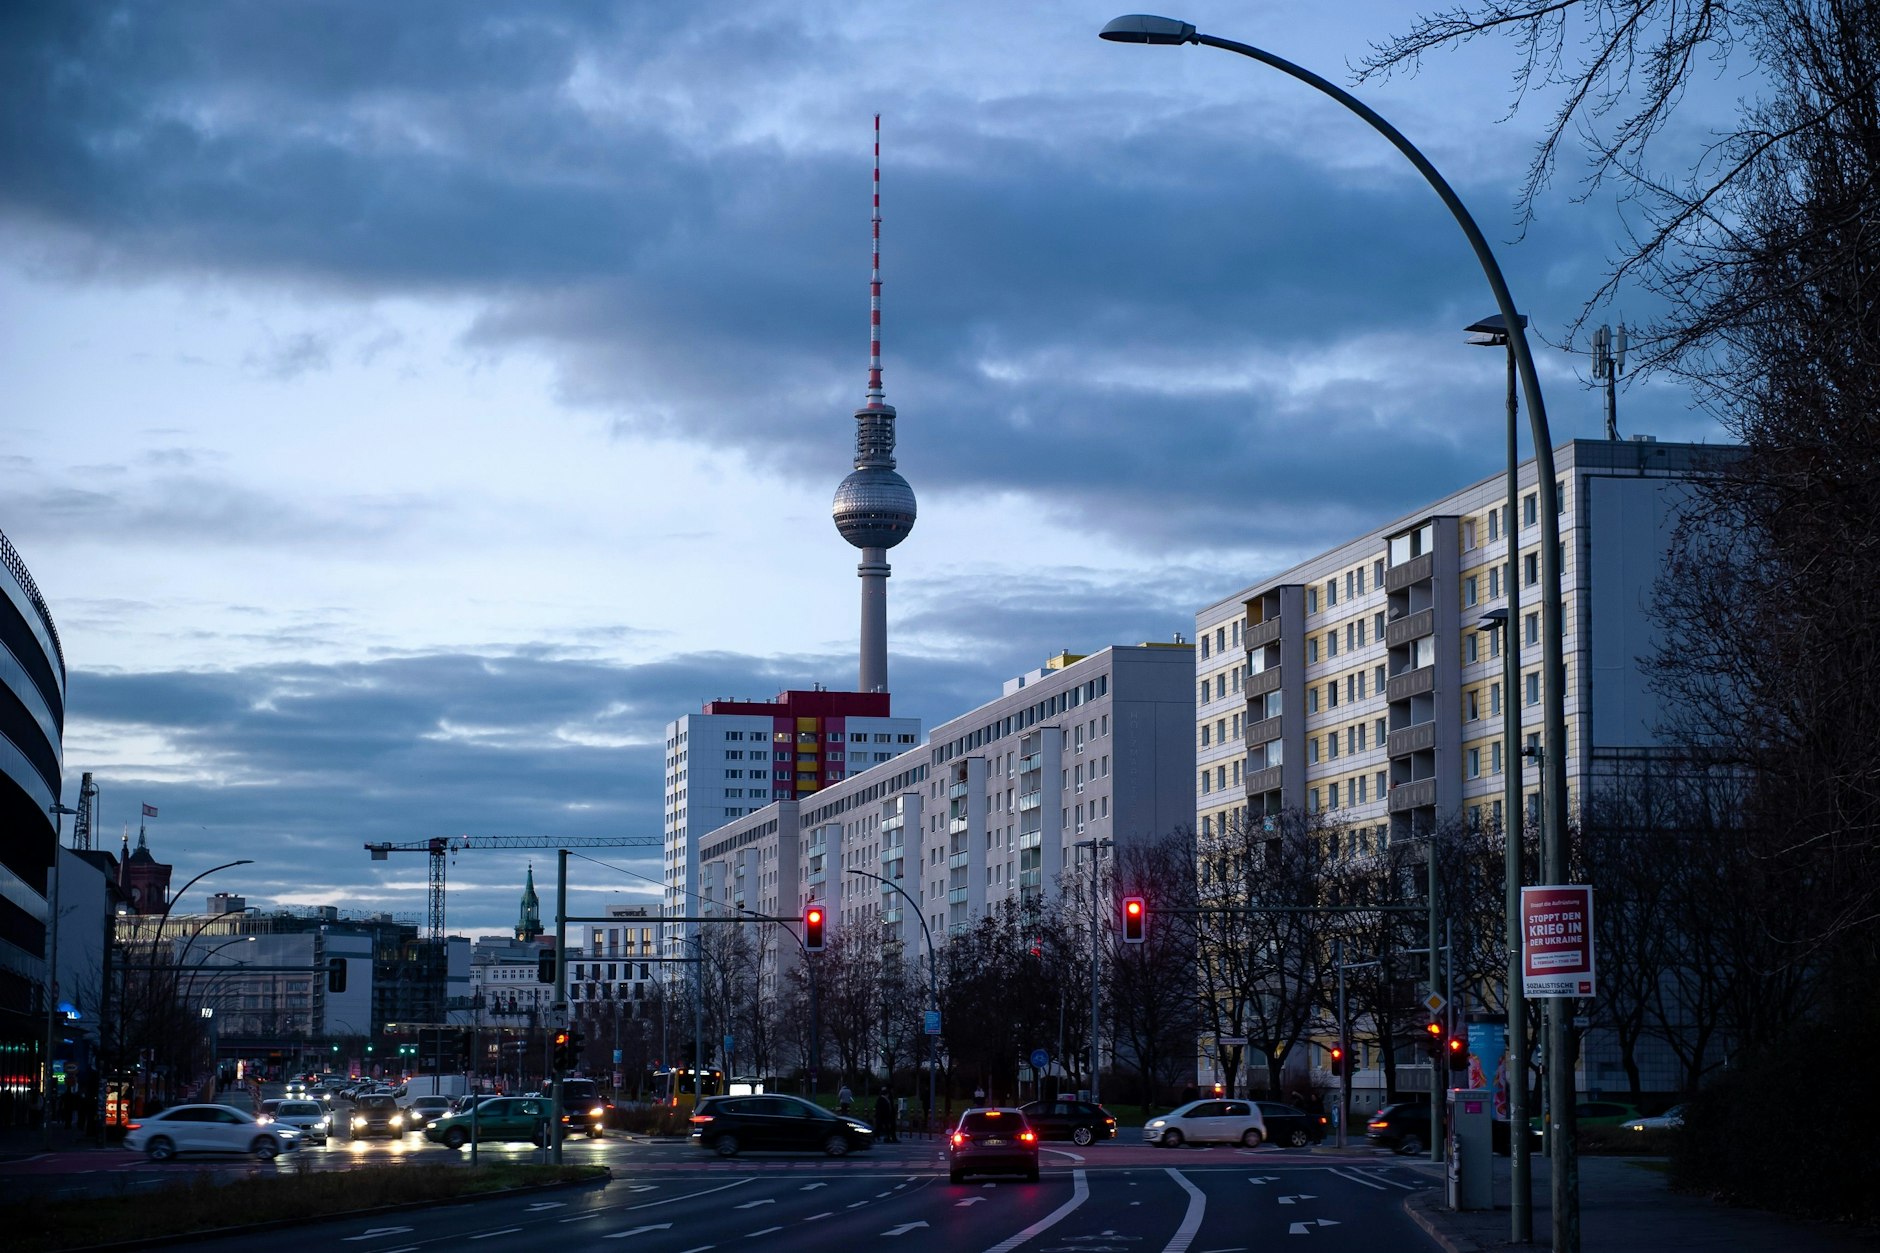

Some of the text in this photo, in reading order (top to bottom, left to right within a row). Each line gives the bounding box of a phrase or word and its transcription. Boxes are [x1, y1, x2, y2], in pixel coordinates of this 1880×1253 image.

[1529, 912, 1581, 923] STOPPT DEN
[1529, 921, 1582, 937] KRIEG IN
[1530, 935, 1583, 947] DER UKRAINE
